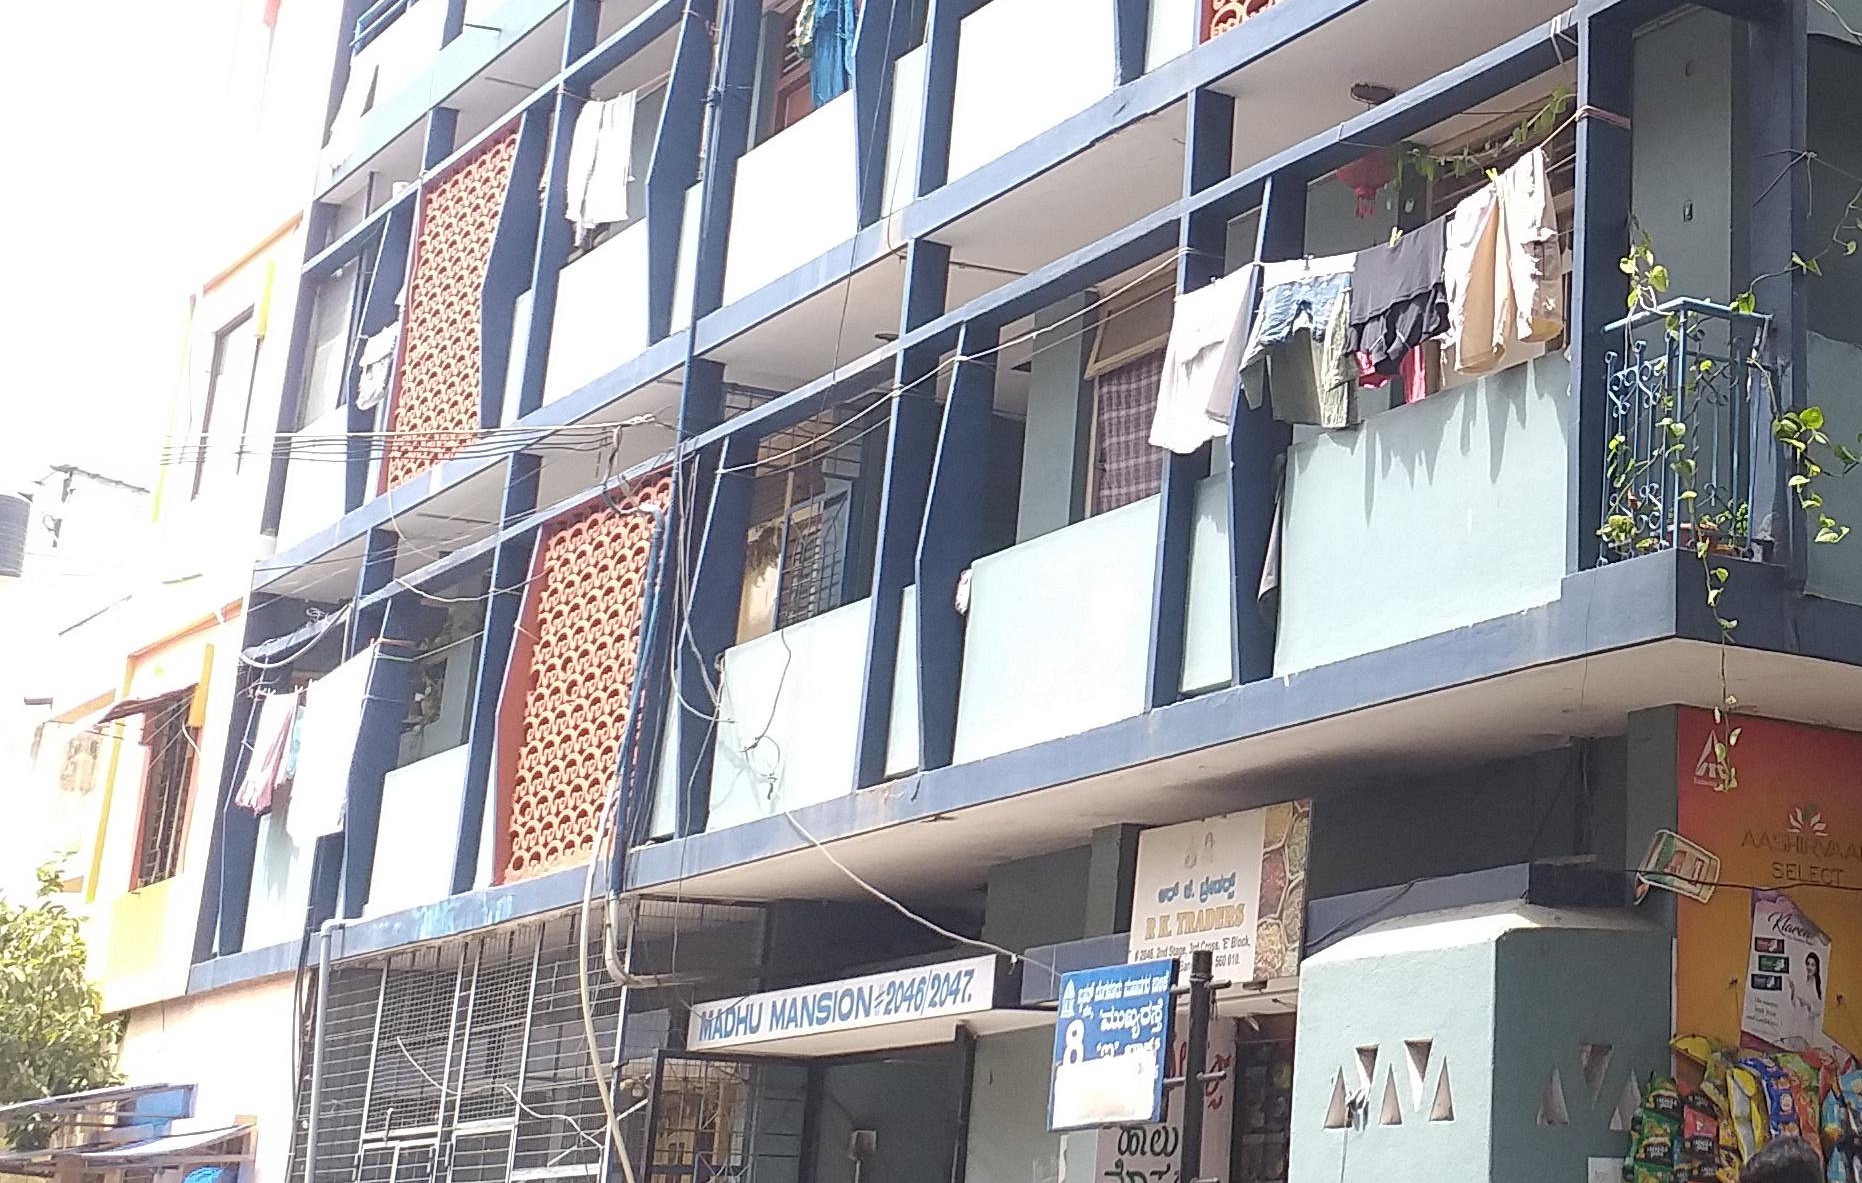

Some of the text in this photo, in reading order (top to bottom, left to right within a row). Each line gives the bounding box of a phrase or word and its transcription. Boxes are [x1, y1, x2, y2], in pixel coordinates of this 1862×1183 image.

[1772, 862, 1845, 884] SELECT
[1177, 903, 1245, 935] TRADERS
[700, 1003, 763, 1041] MADHU
[769, 984, 873, 1031] MANSION
